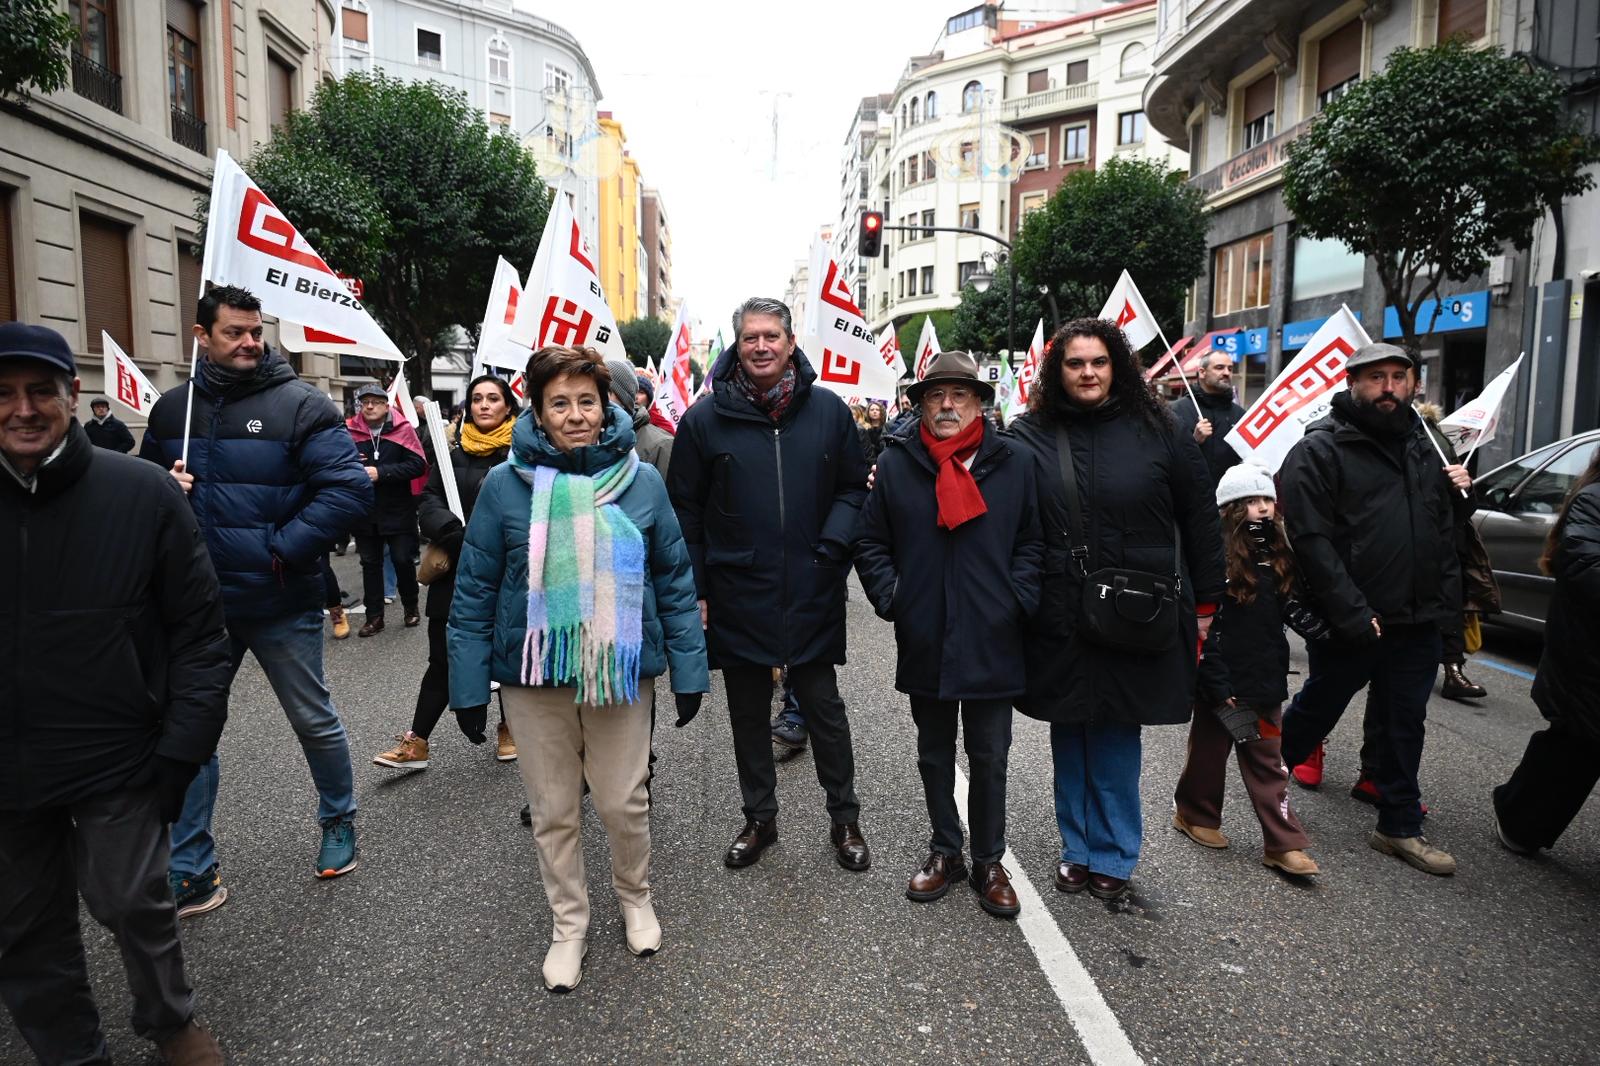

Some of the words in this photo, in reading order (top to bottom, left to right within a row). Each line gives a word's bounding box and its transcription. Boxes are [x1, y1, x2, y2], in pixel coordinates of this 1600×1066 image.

[265, 268, 289, 287] El
[590, 280, 601, 298] El
[834, 317, 849, 332] El
[1241, 342, 1352, 444] CCOO
